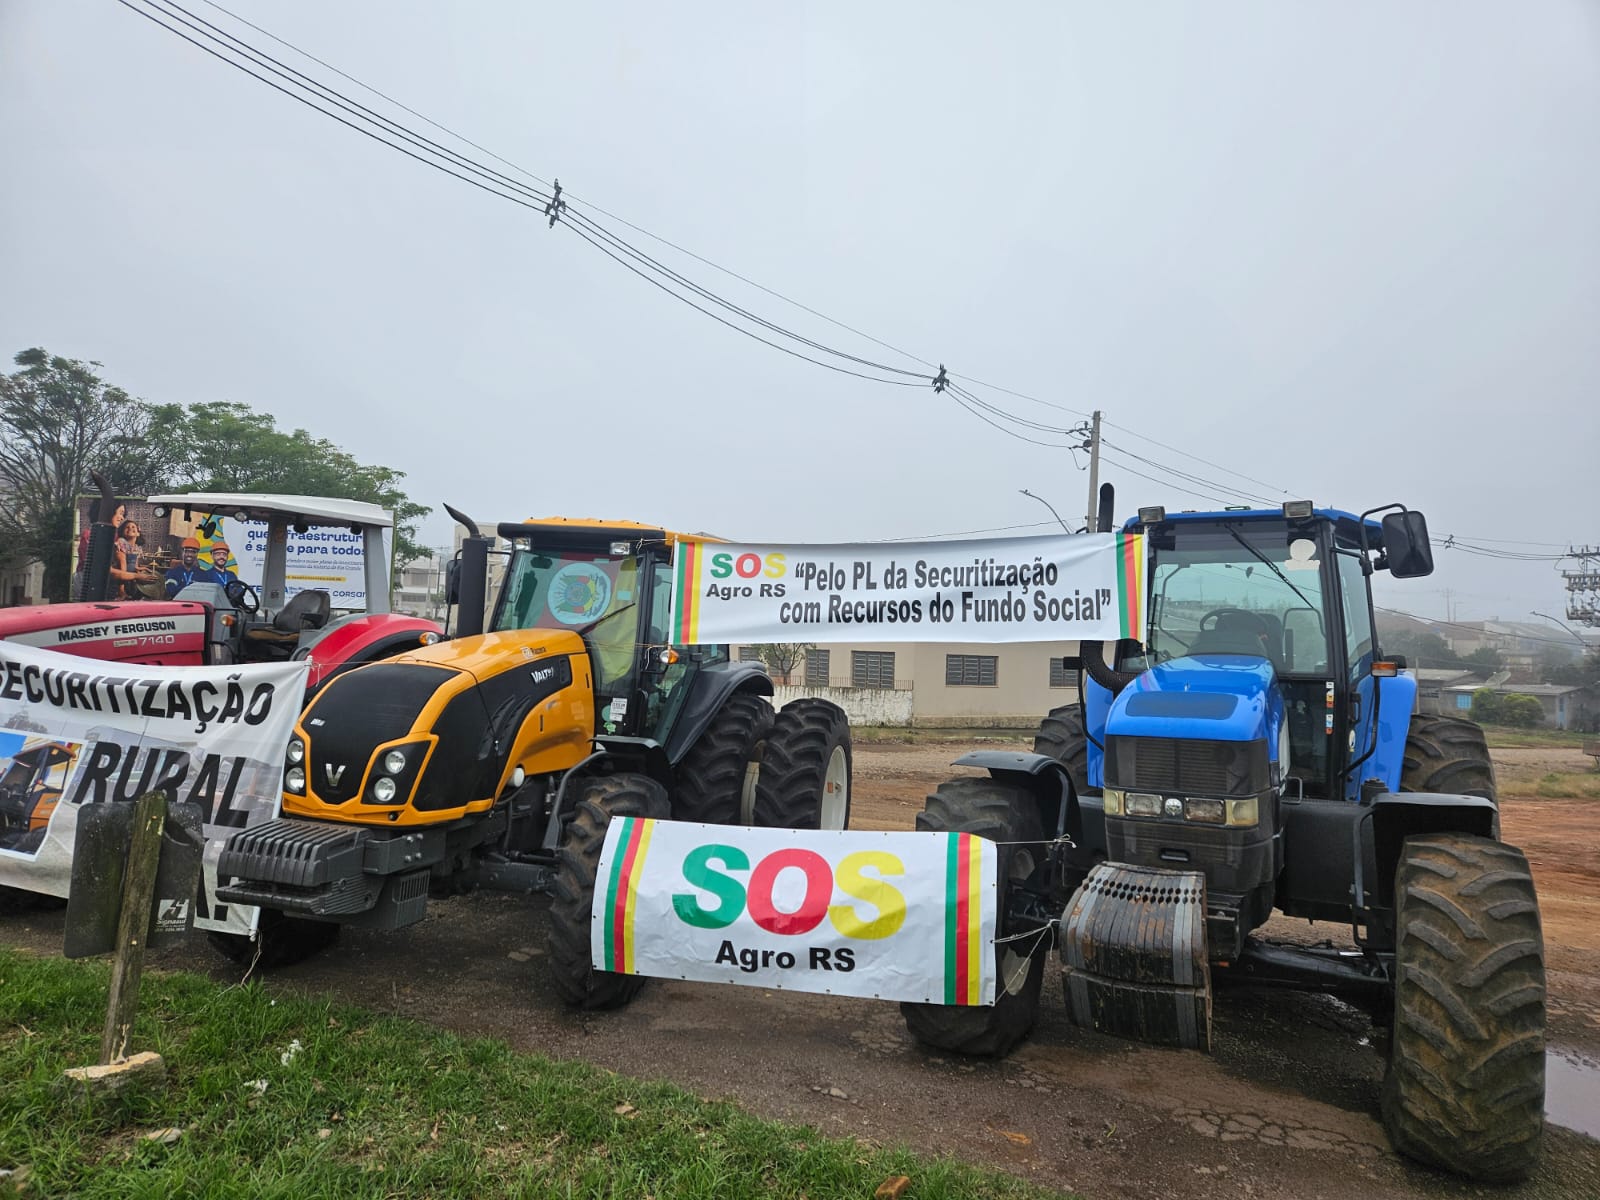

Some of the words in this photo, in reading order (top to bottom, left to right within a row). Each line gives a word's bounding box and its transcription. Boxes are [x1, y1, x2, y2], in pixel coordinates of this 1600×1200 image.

[245, 541, 253, 551] é
[256, 544, 294, 553] sae
[297, 545, 328, 555] para
[248, 530, 269, 540] que
[710, 553, 787, 579] SOS
[853, 561, 877, 590] PL
[884, 560, 908, 589] da
[914, 556, 1058, 594] Securitização
[706, 583, 752, 601] Agro
[759, 583, 786, 598] RS
[779, 600, 821, 624] com
[828, 594, 922, 624] Recursos
[929, 591, 954, 623] do
[961, 591, 1026, 623] Fundo
[58, 626, 109, 642] MASSEY
[114, 620, 176, 635] FERGUSON
[138, 634, 175, 646] 7140
[0, 661, 275, 733] ECURITIZAÇÃO
[672, 843, 907, 940] SOS
[715, 940, 796, 973] Agro
[808, 947, 856, 973] RS
